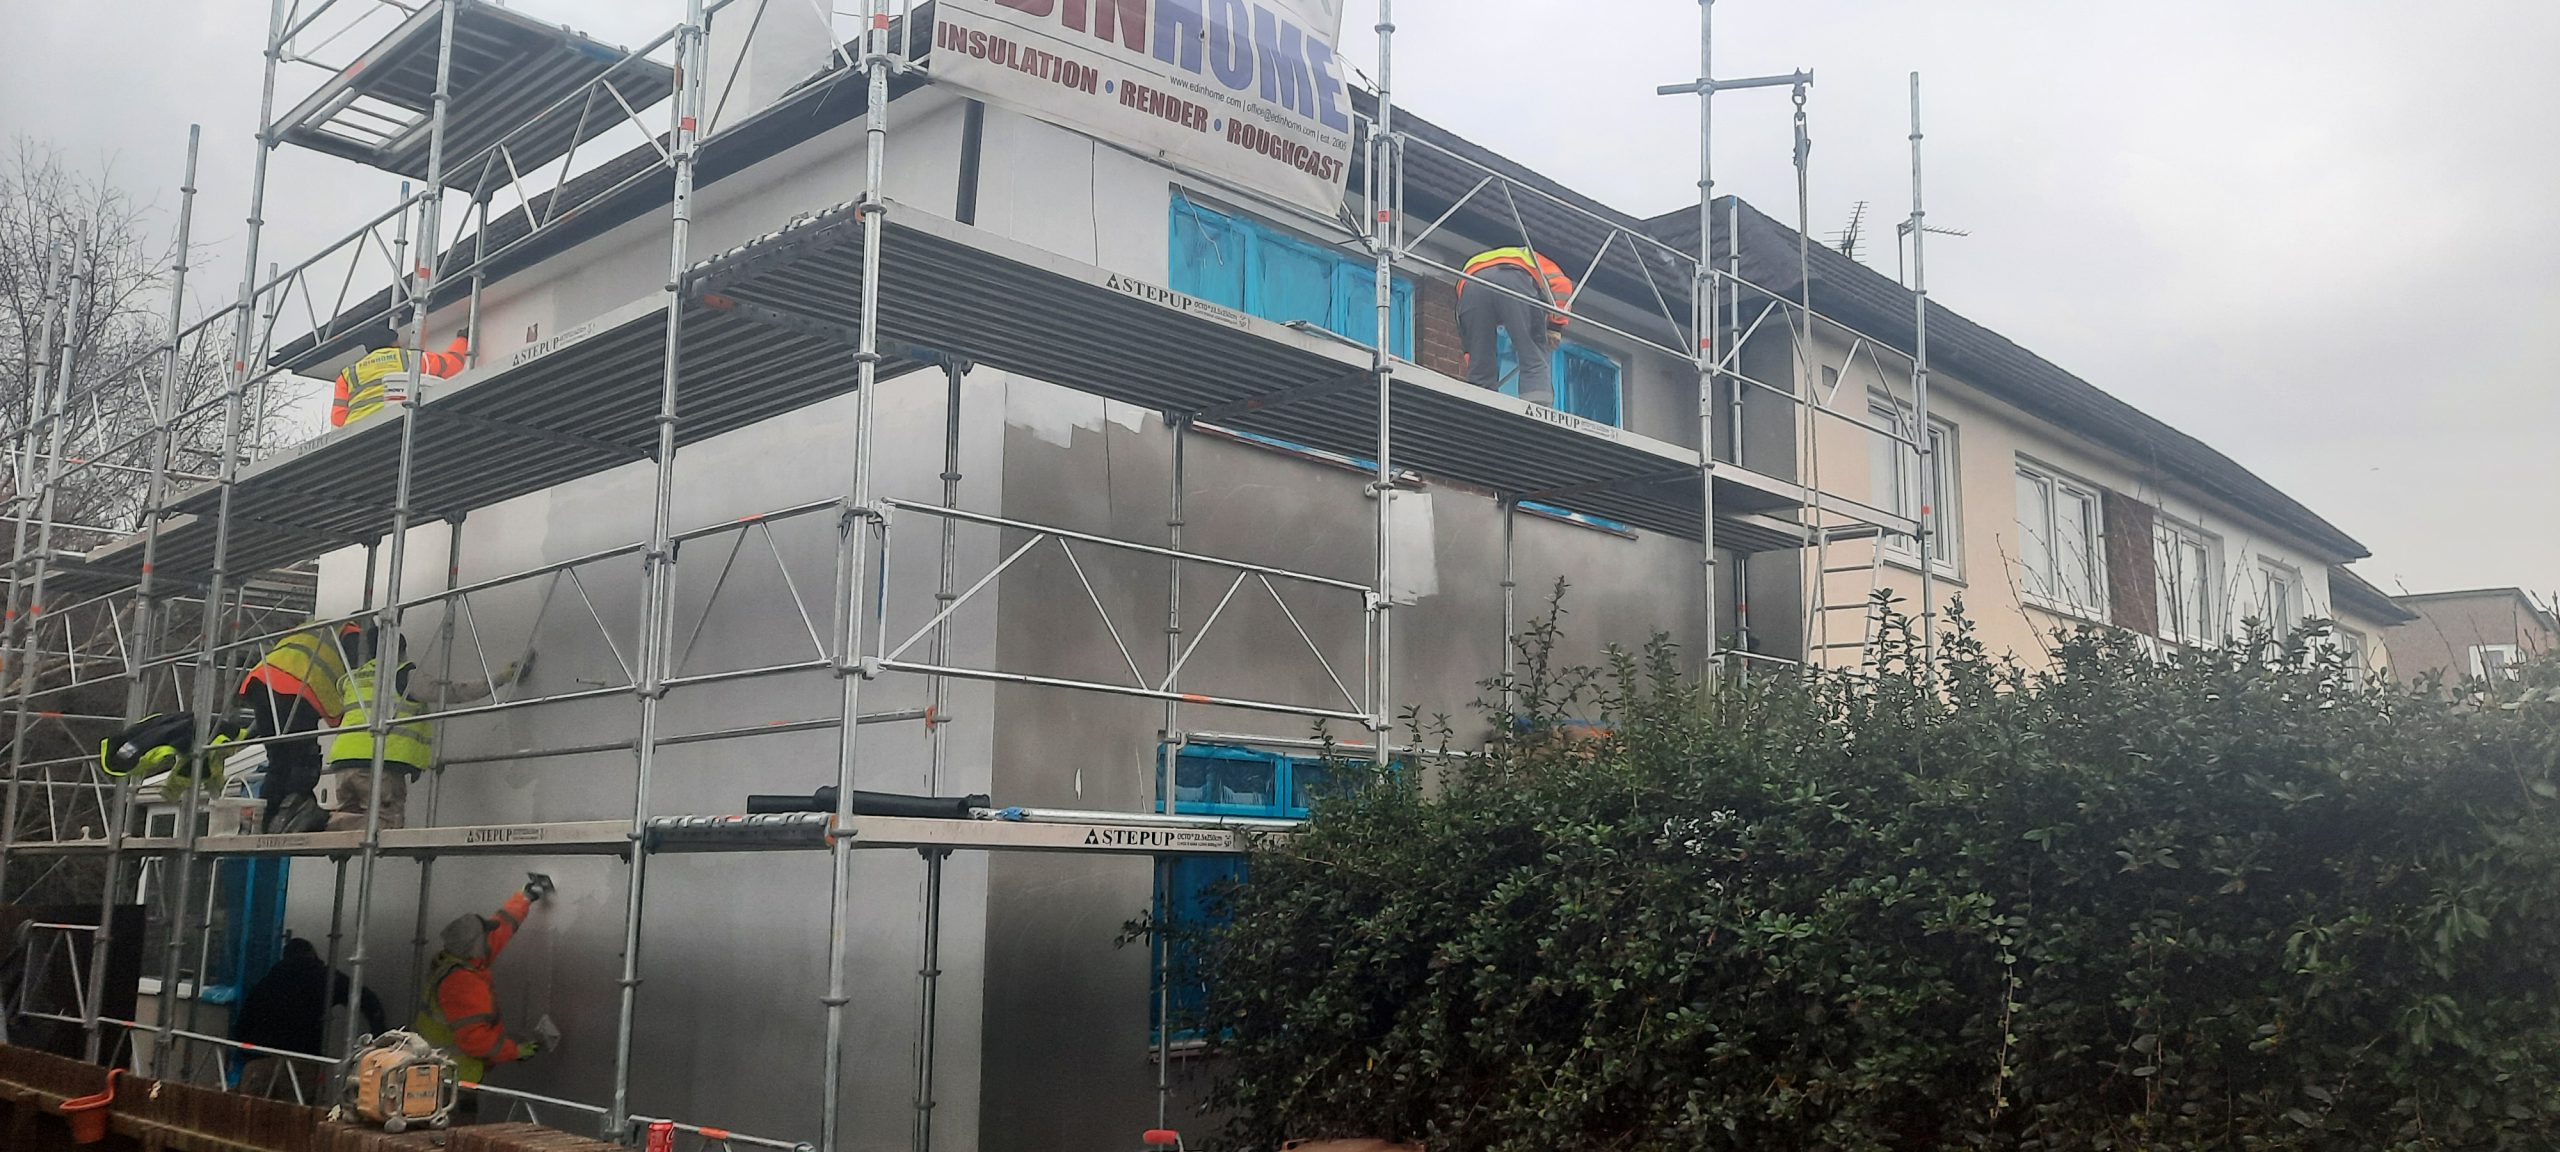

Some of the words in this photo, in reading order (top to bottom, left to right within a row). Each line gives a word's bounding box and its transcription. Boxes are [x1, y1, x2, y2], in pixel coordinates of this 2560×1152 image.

[937, 21, 1098, 95] INSULATION
[1119, 79, 1208, 133] RENDER
[1226, 117, 1344, 184] ROUGHCAST
[1122, 278, 1192, 311] STEPUP
[1535, 406, 1580, 429] STEPUP
[475, 828, 512, 842] STEPUP
[1102, 829, 1175, 847] STEPUP
